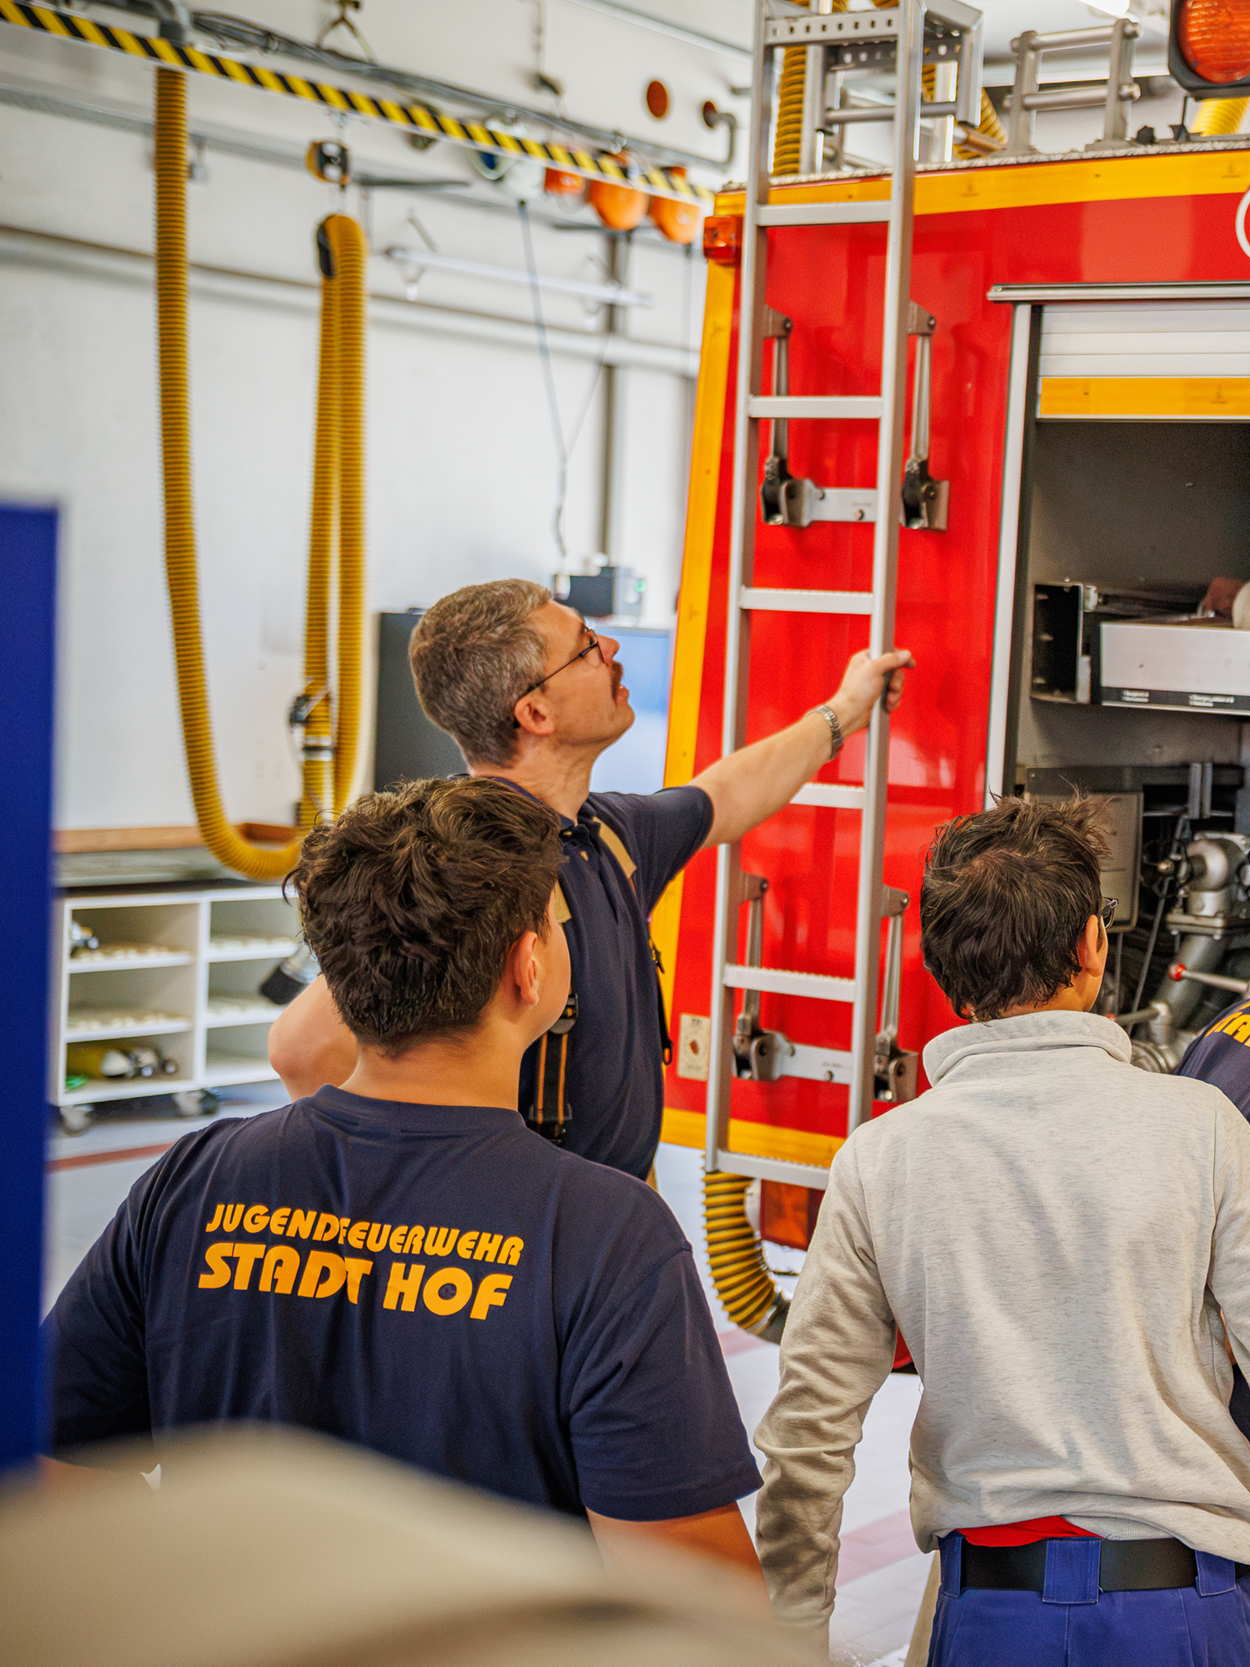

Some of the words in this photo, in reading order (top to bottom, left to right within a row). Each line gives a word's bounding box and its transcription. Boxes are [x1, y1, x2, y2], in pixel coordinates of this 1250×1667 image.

[205, 1203, 525, 1266] JUGENDFEUERWEHR
[197, 1242, 374, 1305] STADT
[382, 1262, 514, 1321] HOF
